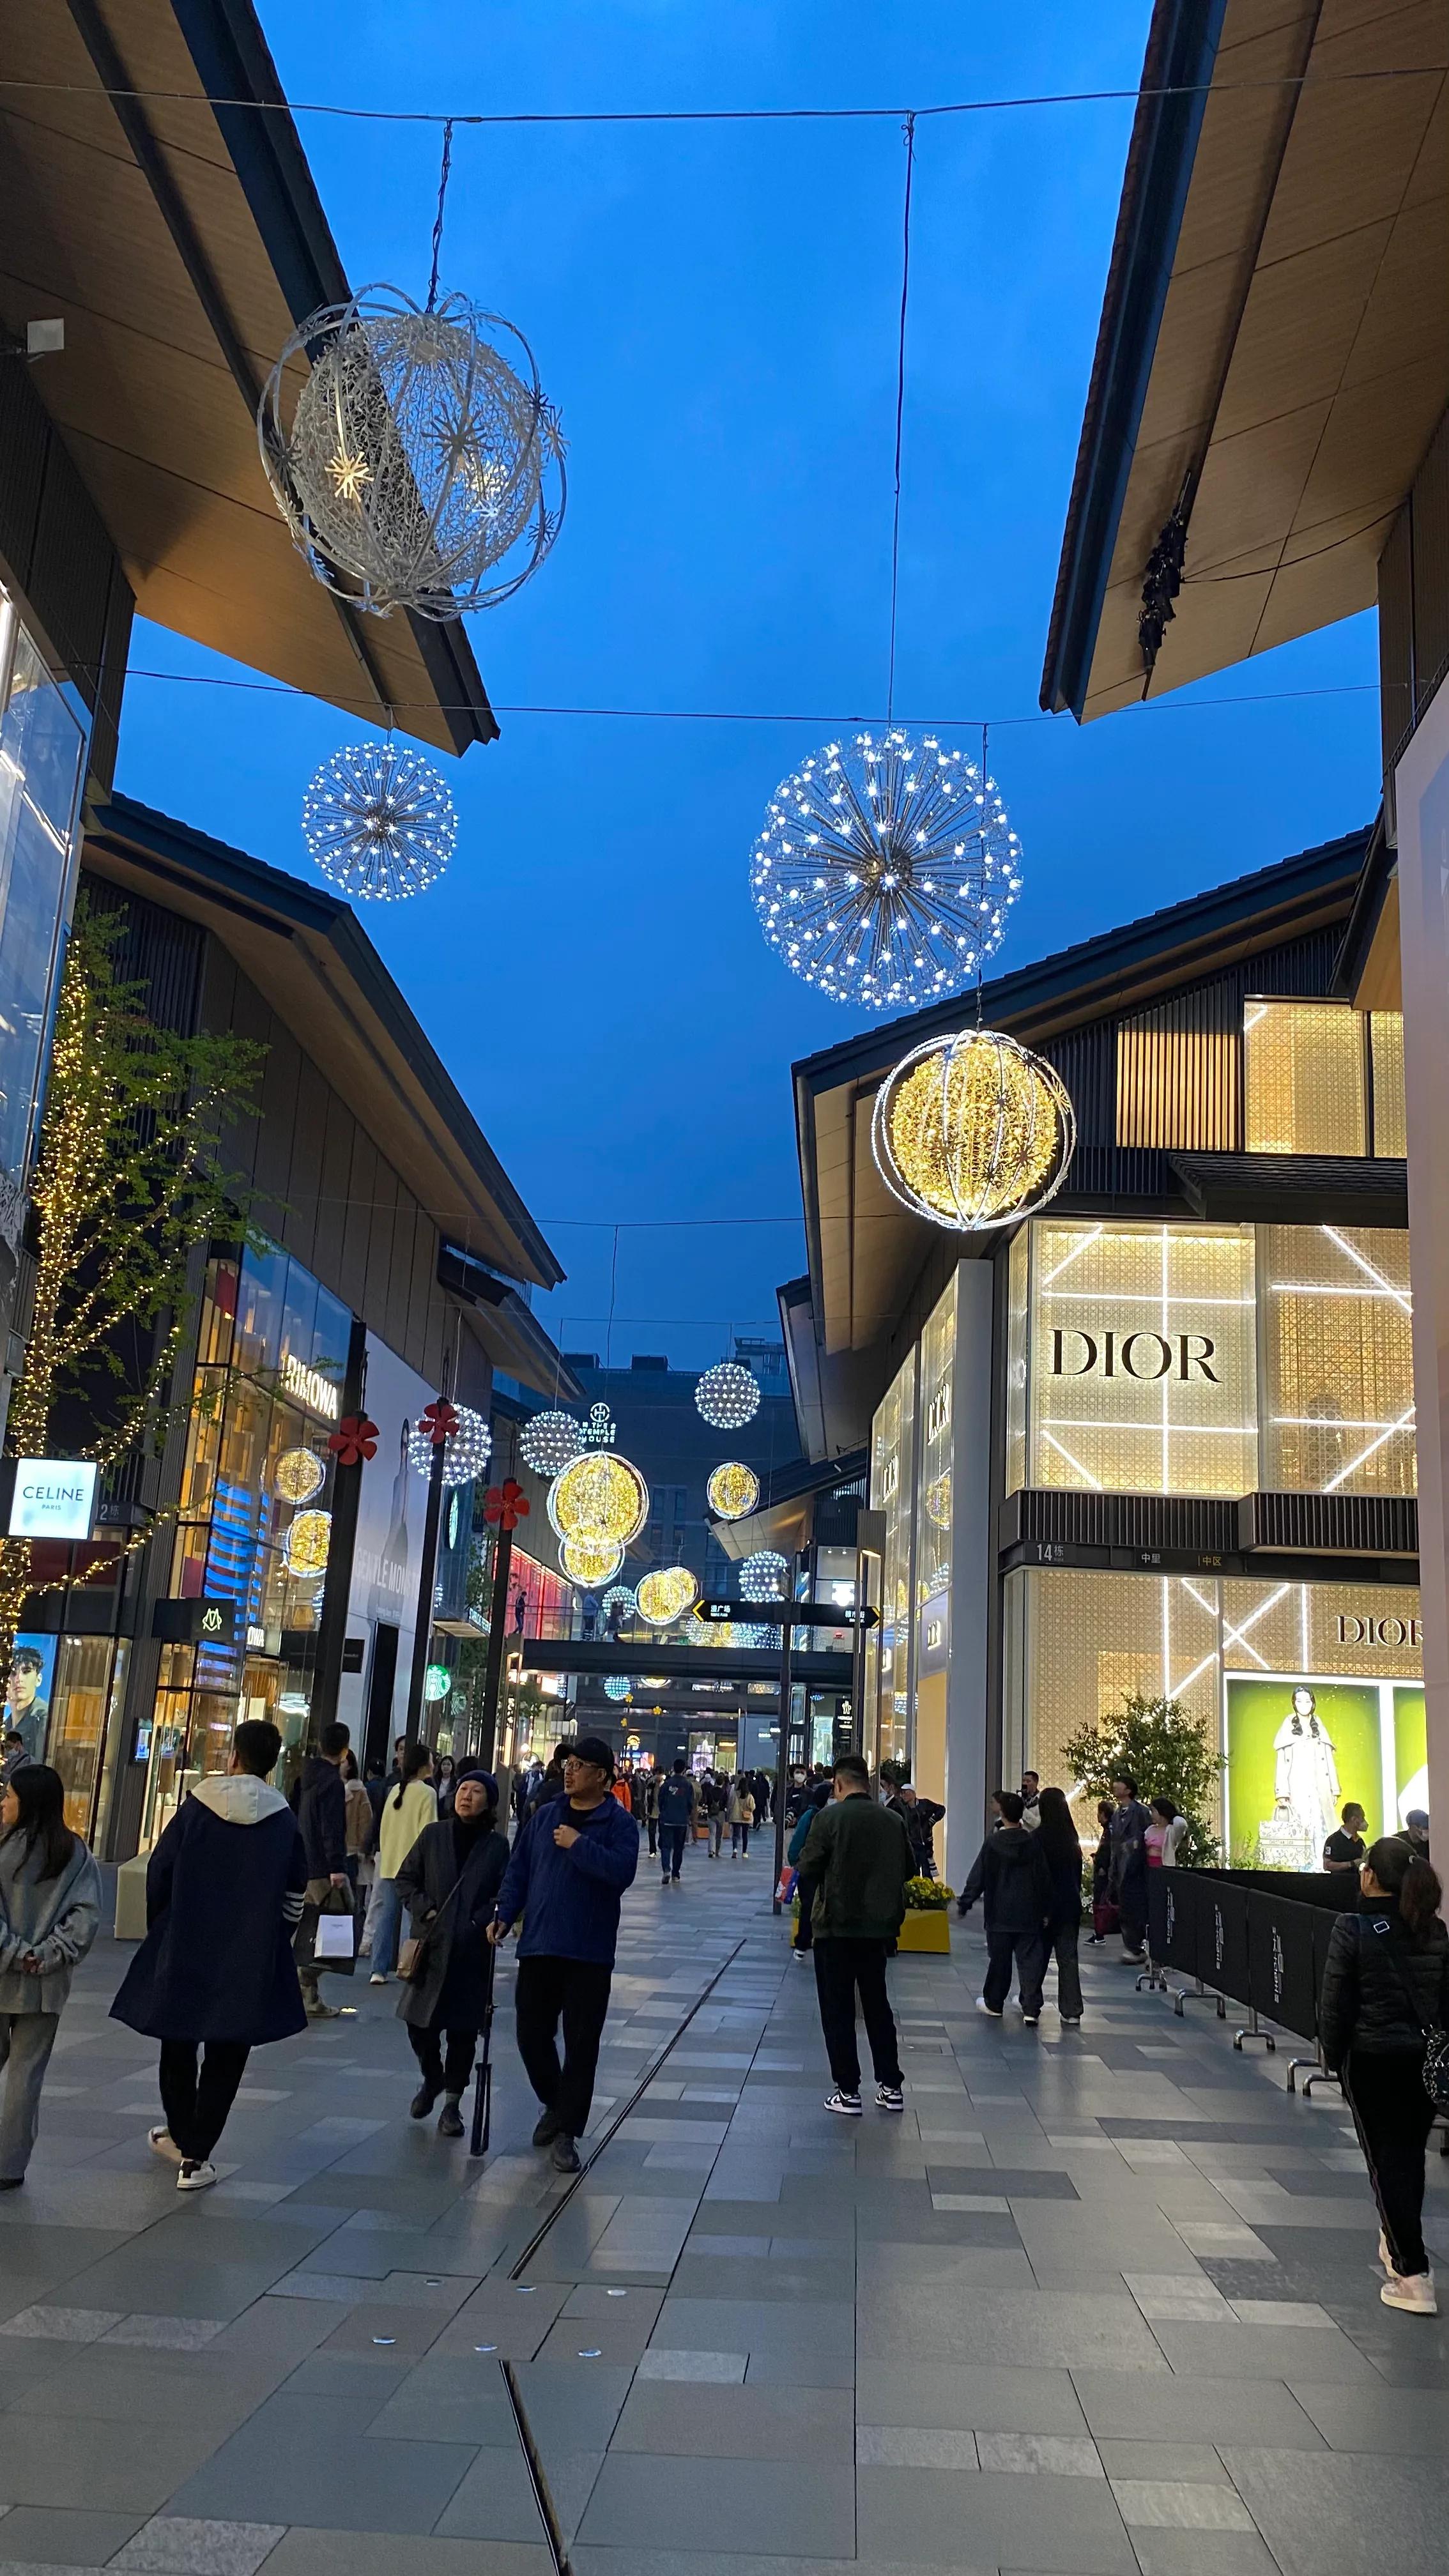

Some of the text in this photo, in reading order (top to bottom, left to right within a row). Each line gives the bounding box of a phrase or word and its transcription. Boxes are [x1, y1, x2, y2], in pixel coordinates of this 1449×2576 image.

[1047, 1329, 1223, 1383] DIOR
[285, 1354, 337, 1420] RIMOWA
[23, 1486, 84, 1501] CELINE
[247, 1625, 264, 1647] OWA
[1335, 1616, 1423, 1648] DIOR
